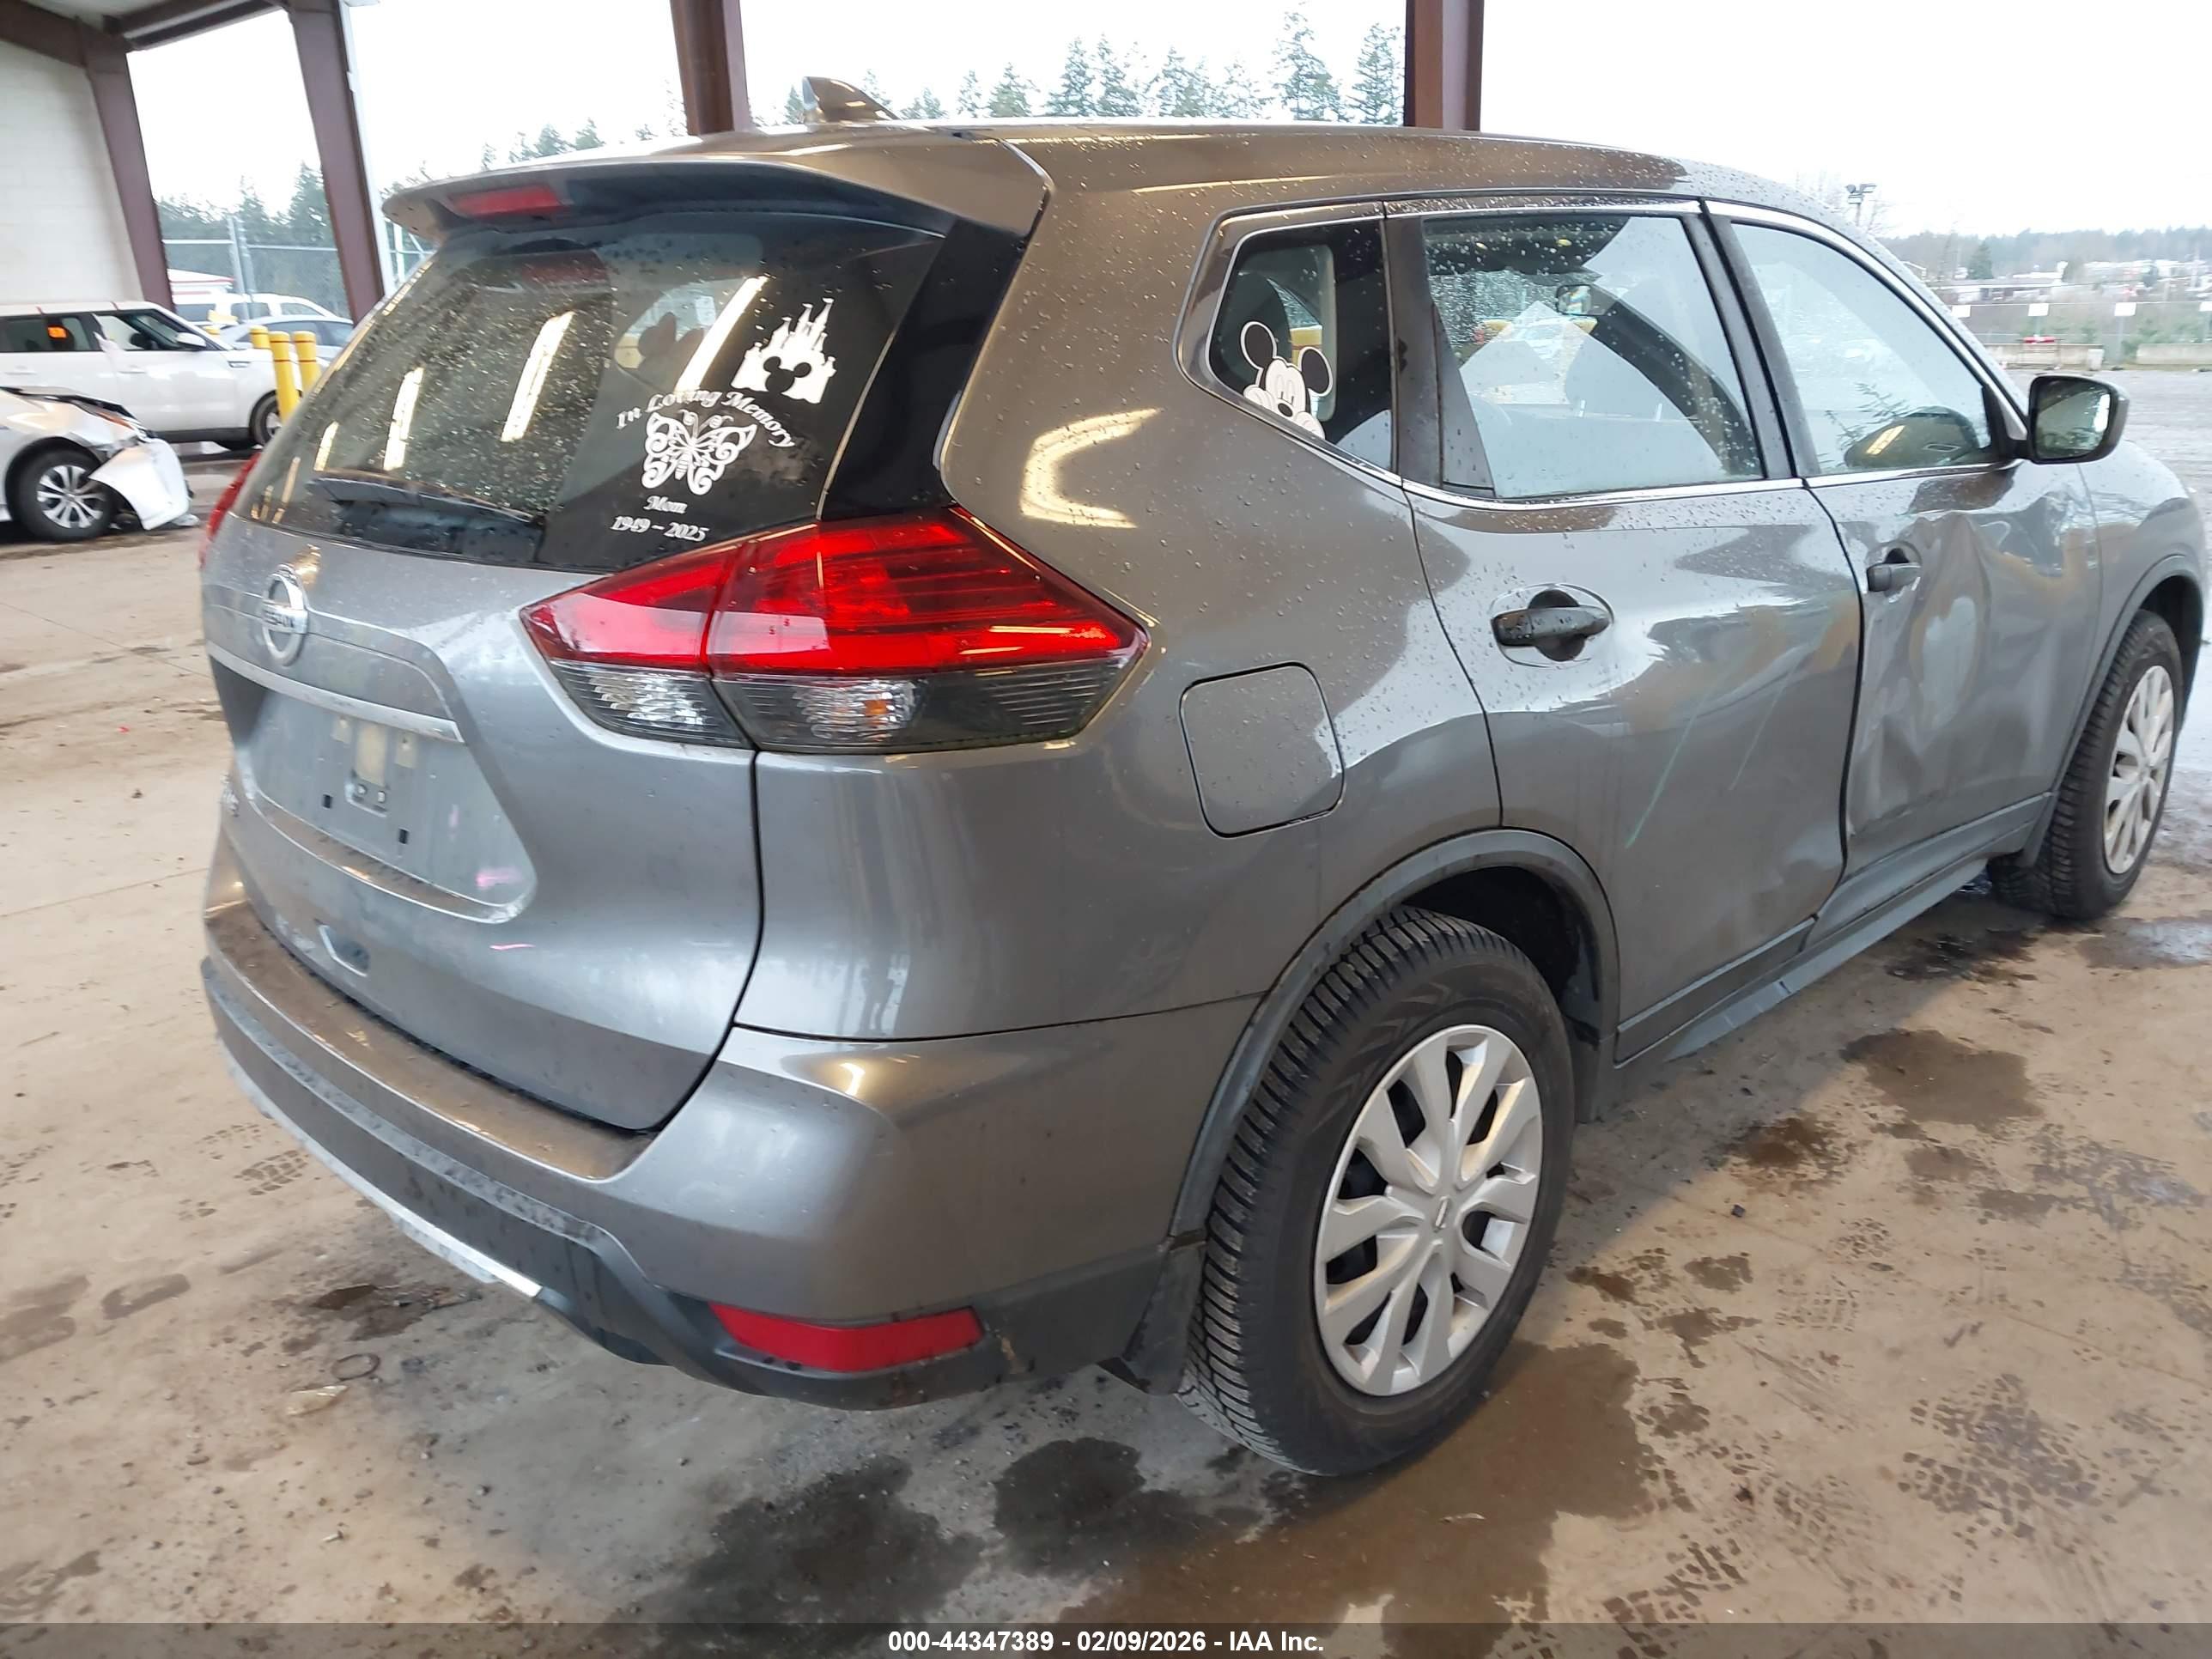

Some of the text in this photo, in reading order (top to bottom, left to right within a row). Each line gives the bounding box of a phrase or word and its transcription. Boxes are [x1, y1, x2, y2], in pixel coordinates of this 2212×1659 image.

[617, 389, 795, 447] In Loving Memory
[643, 495, 688, 514] Mom
[610, 516, 651, 532] 1949
[664, 522, 709, 542] 2025
